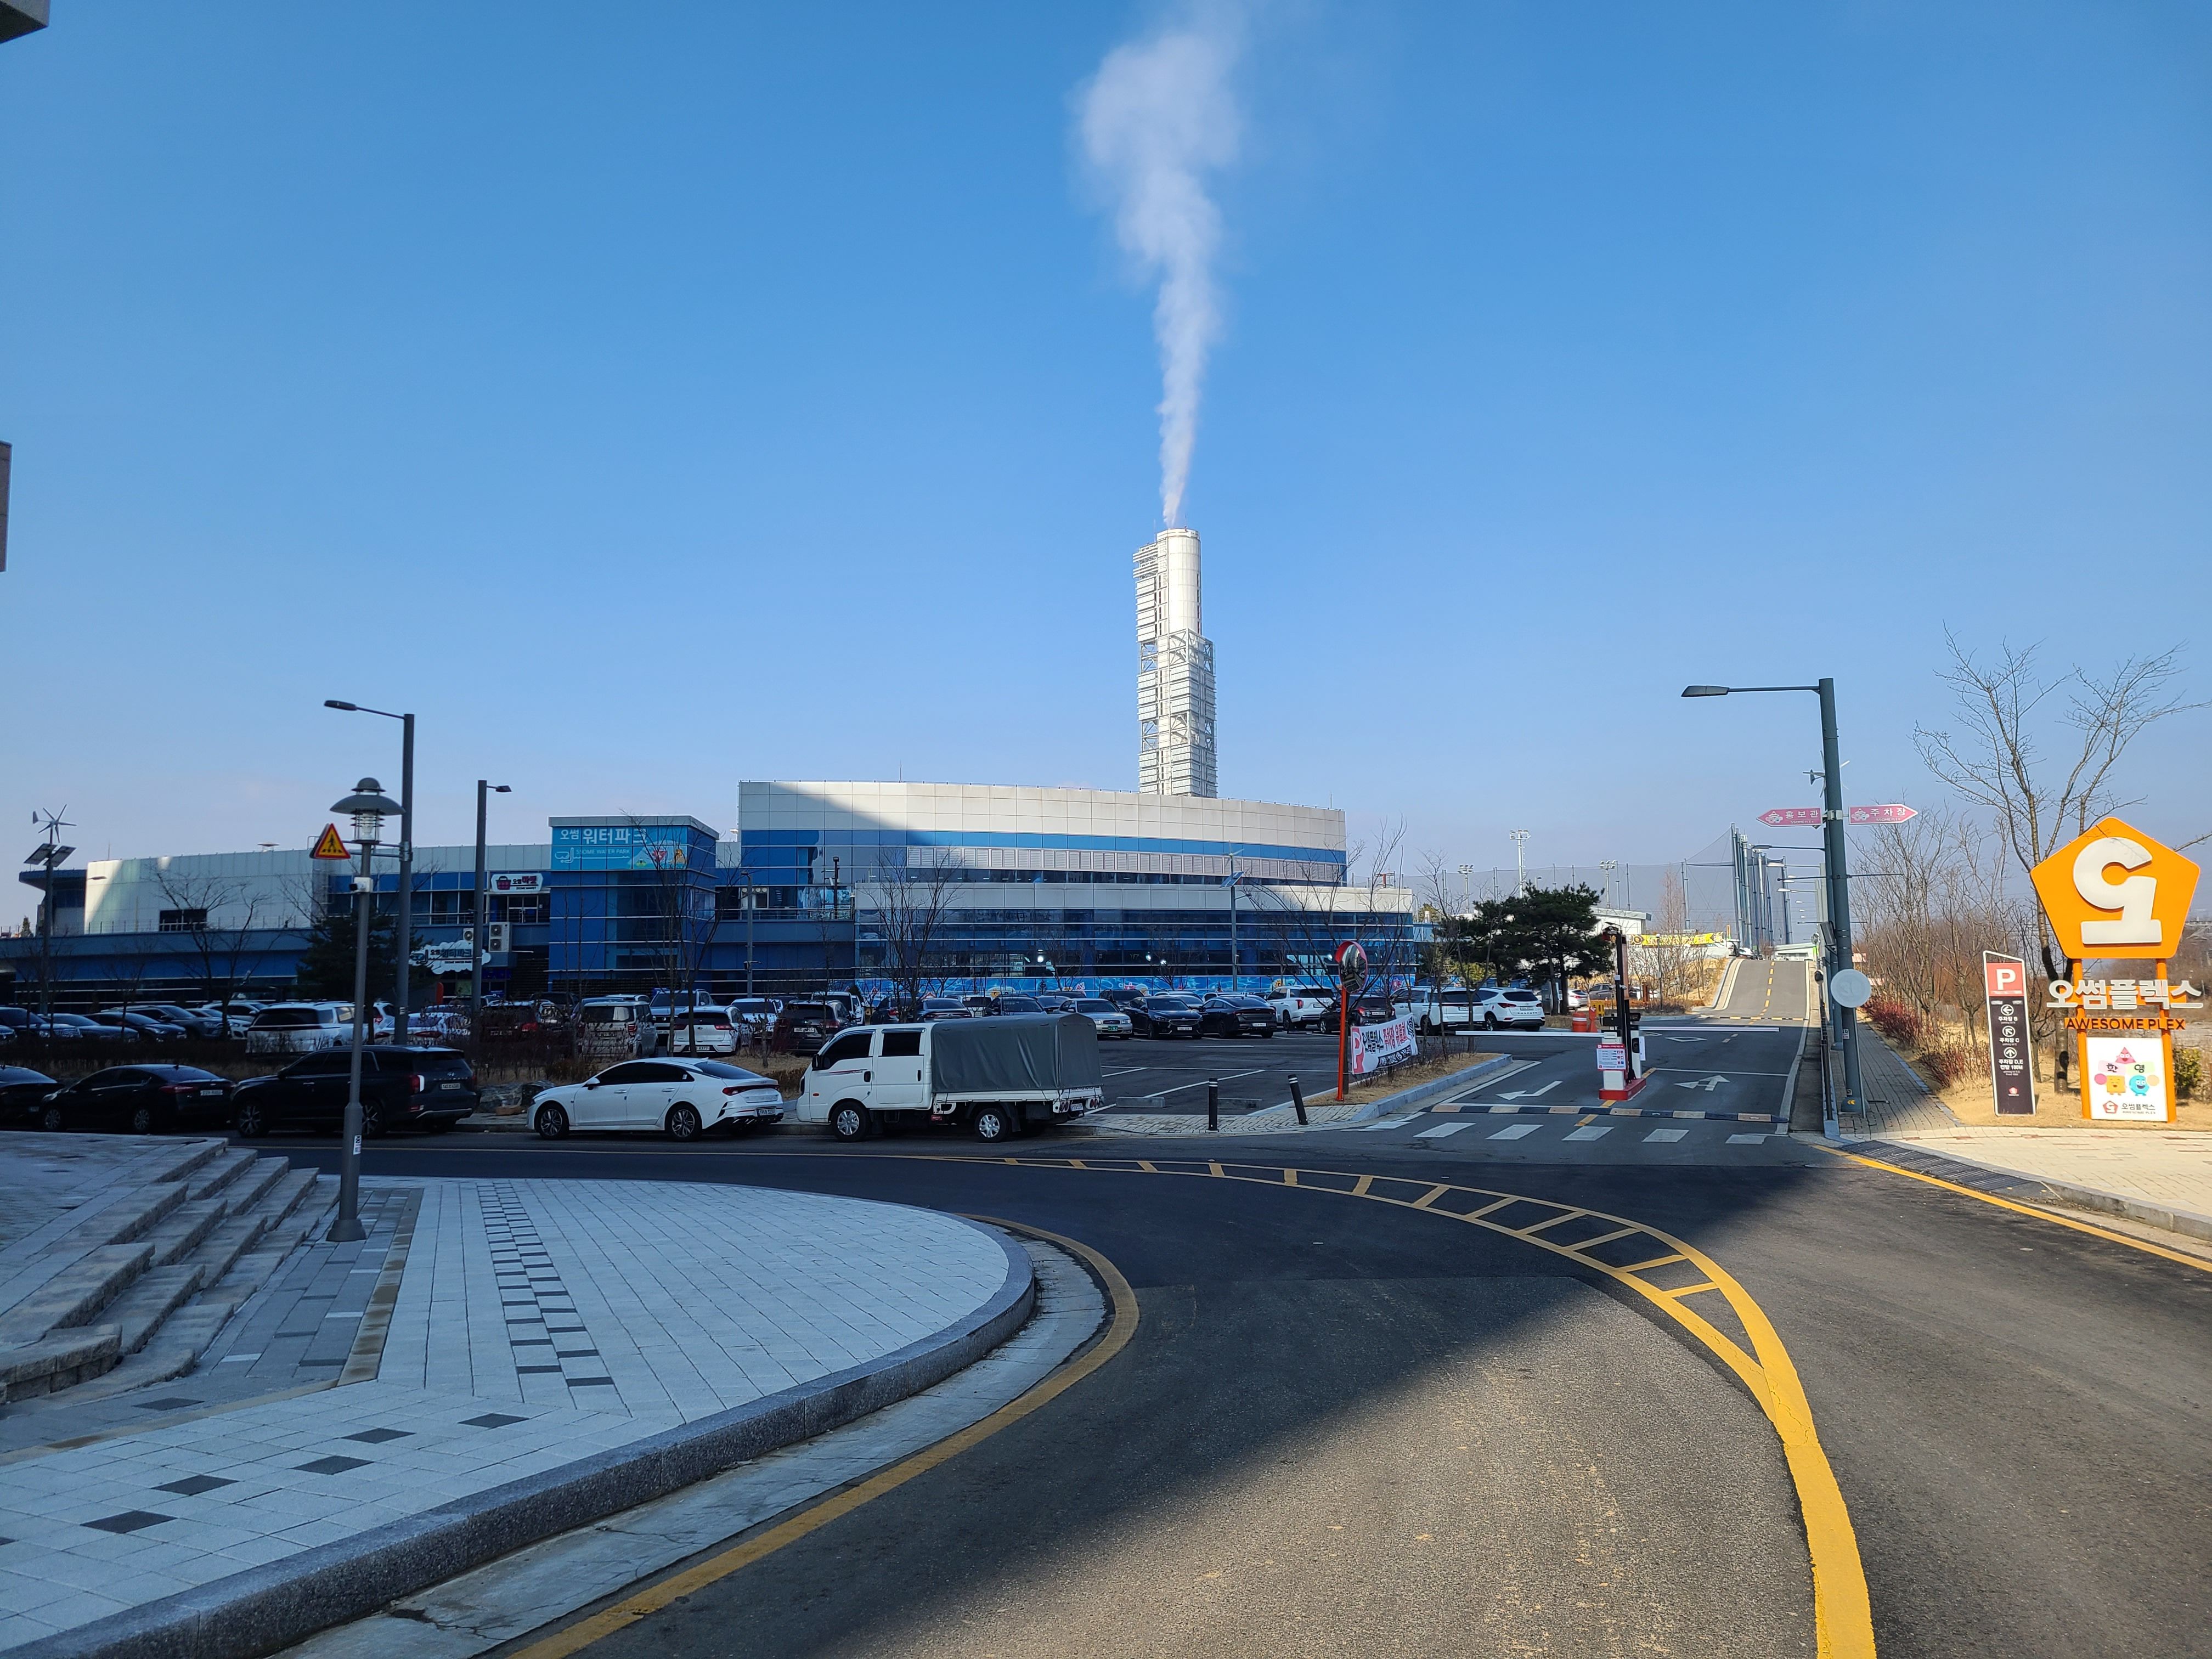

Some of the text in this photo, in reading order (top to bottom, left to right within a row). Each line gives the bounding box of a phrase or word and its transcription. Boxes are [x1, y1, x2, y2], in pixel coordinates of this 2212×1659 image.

[1785, 810, 1818, 819] 홍보관
[1870, 808, 1906, 816] 주차장
[560, 828, 647, 844] 오썸 워터파크
[1996, 968, 2016, 990] P
[2046, 979, 2203, 1010] 오썸플렉스
[2066, 1018, 2185, 1029] AWESOME PLEX
[2134, 1064, 2145, 1073] 영
